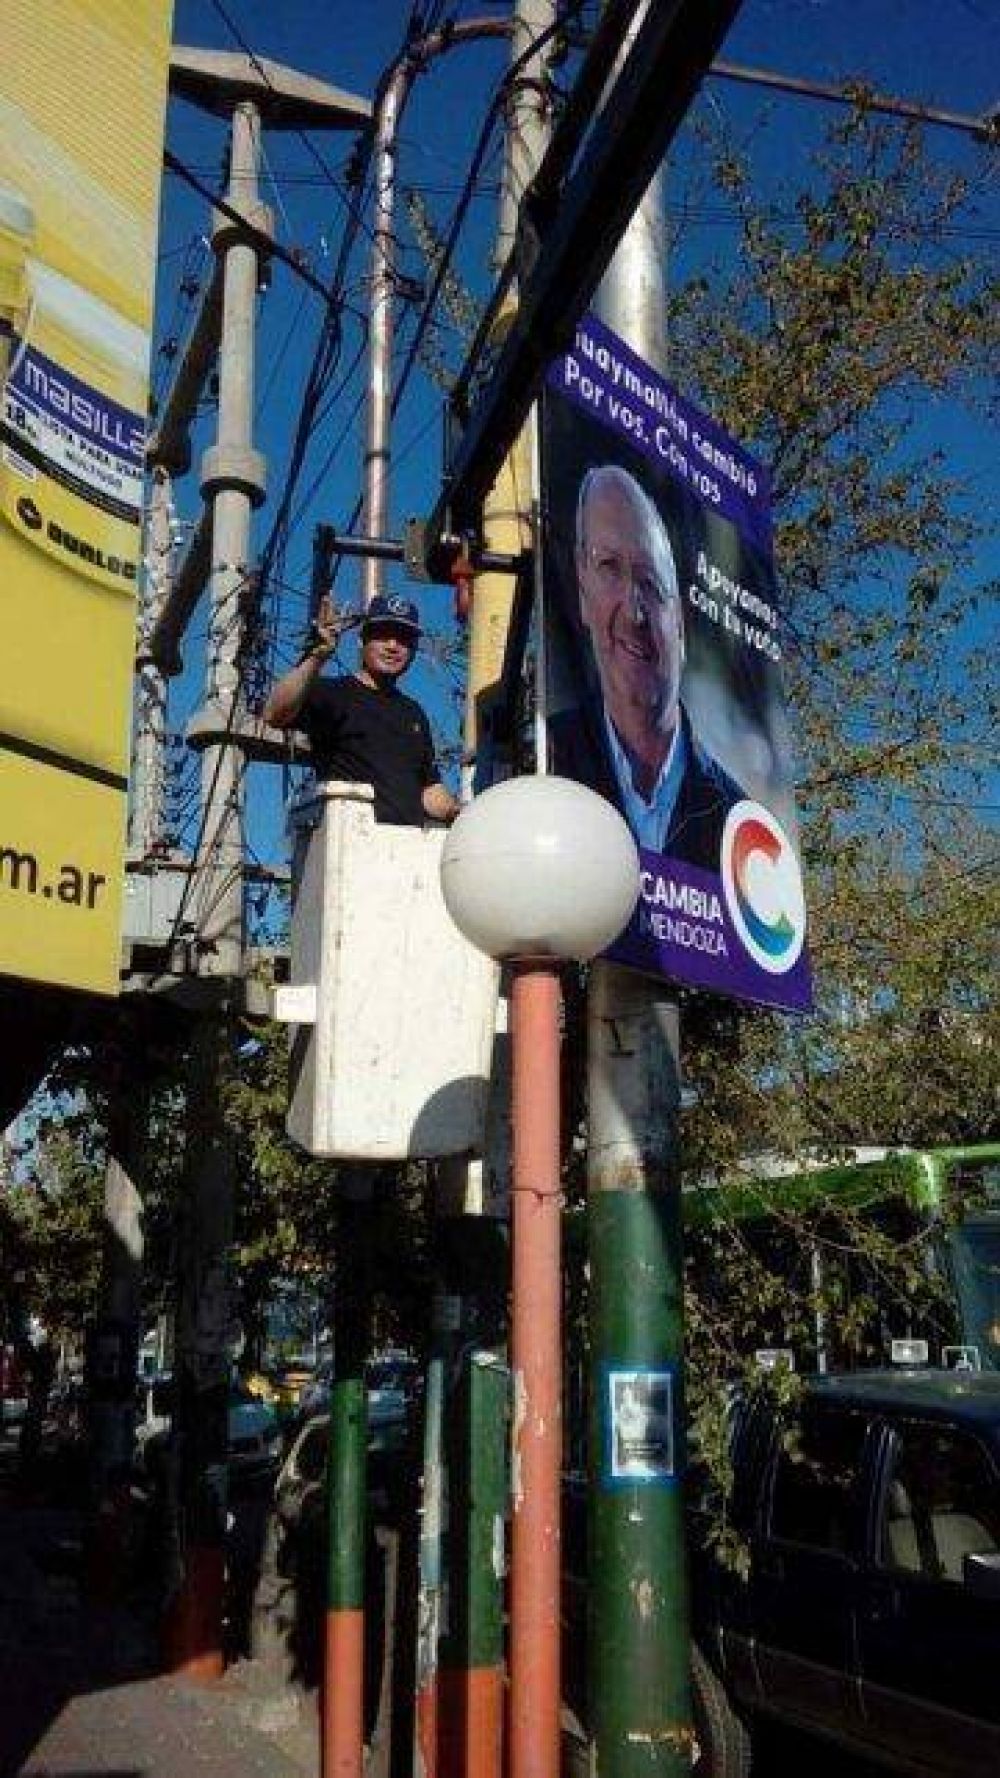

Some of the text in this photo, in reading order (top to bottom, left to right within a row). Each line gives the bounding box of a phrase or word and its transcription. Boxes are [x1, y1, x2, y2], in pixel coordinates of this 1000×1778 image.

[564, 353, 721, 503] Por vos. Con vos
[744, 622, 781, 662] voto
[639, 871, 723, 925] CAMBIA
